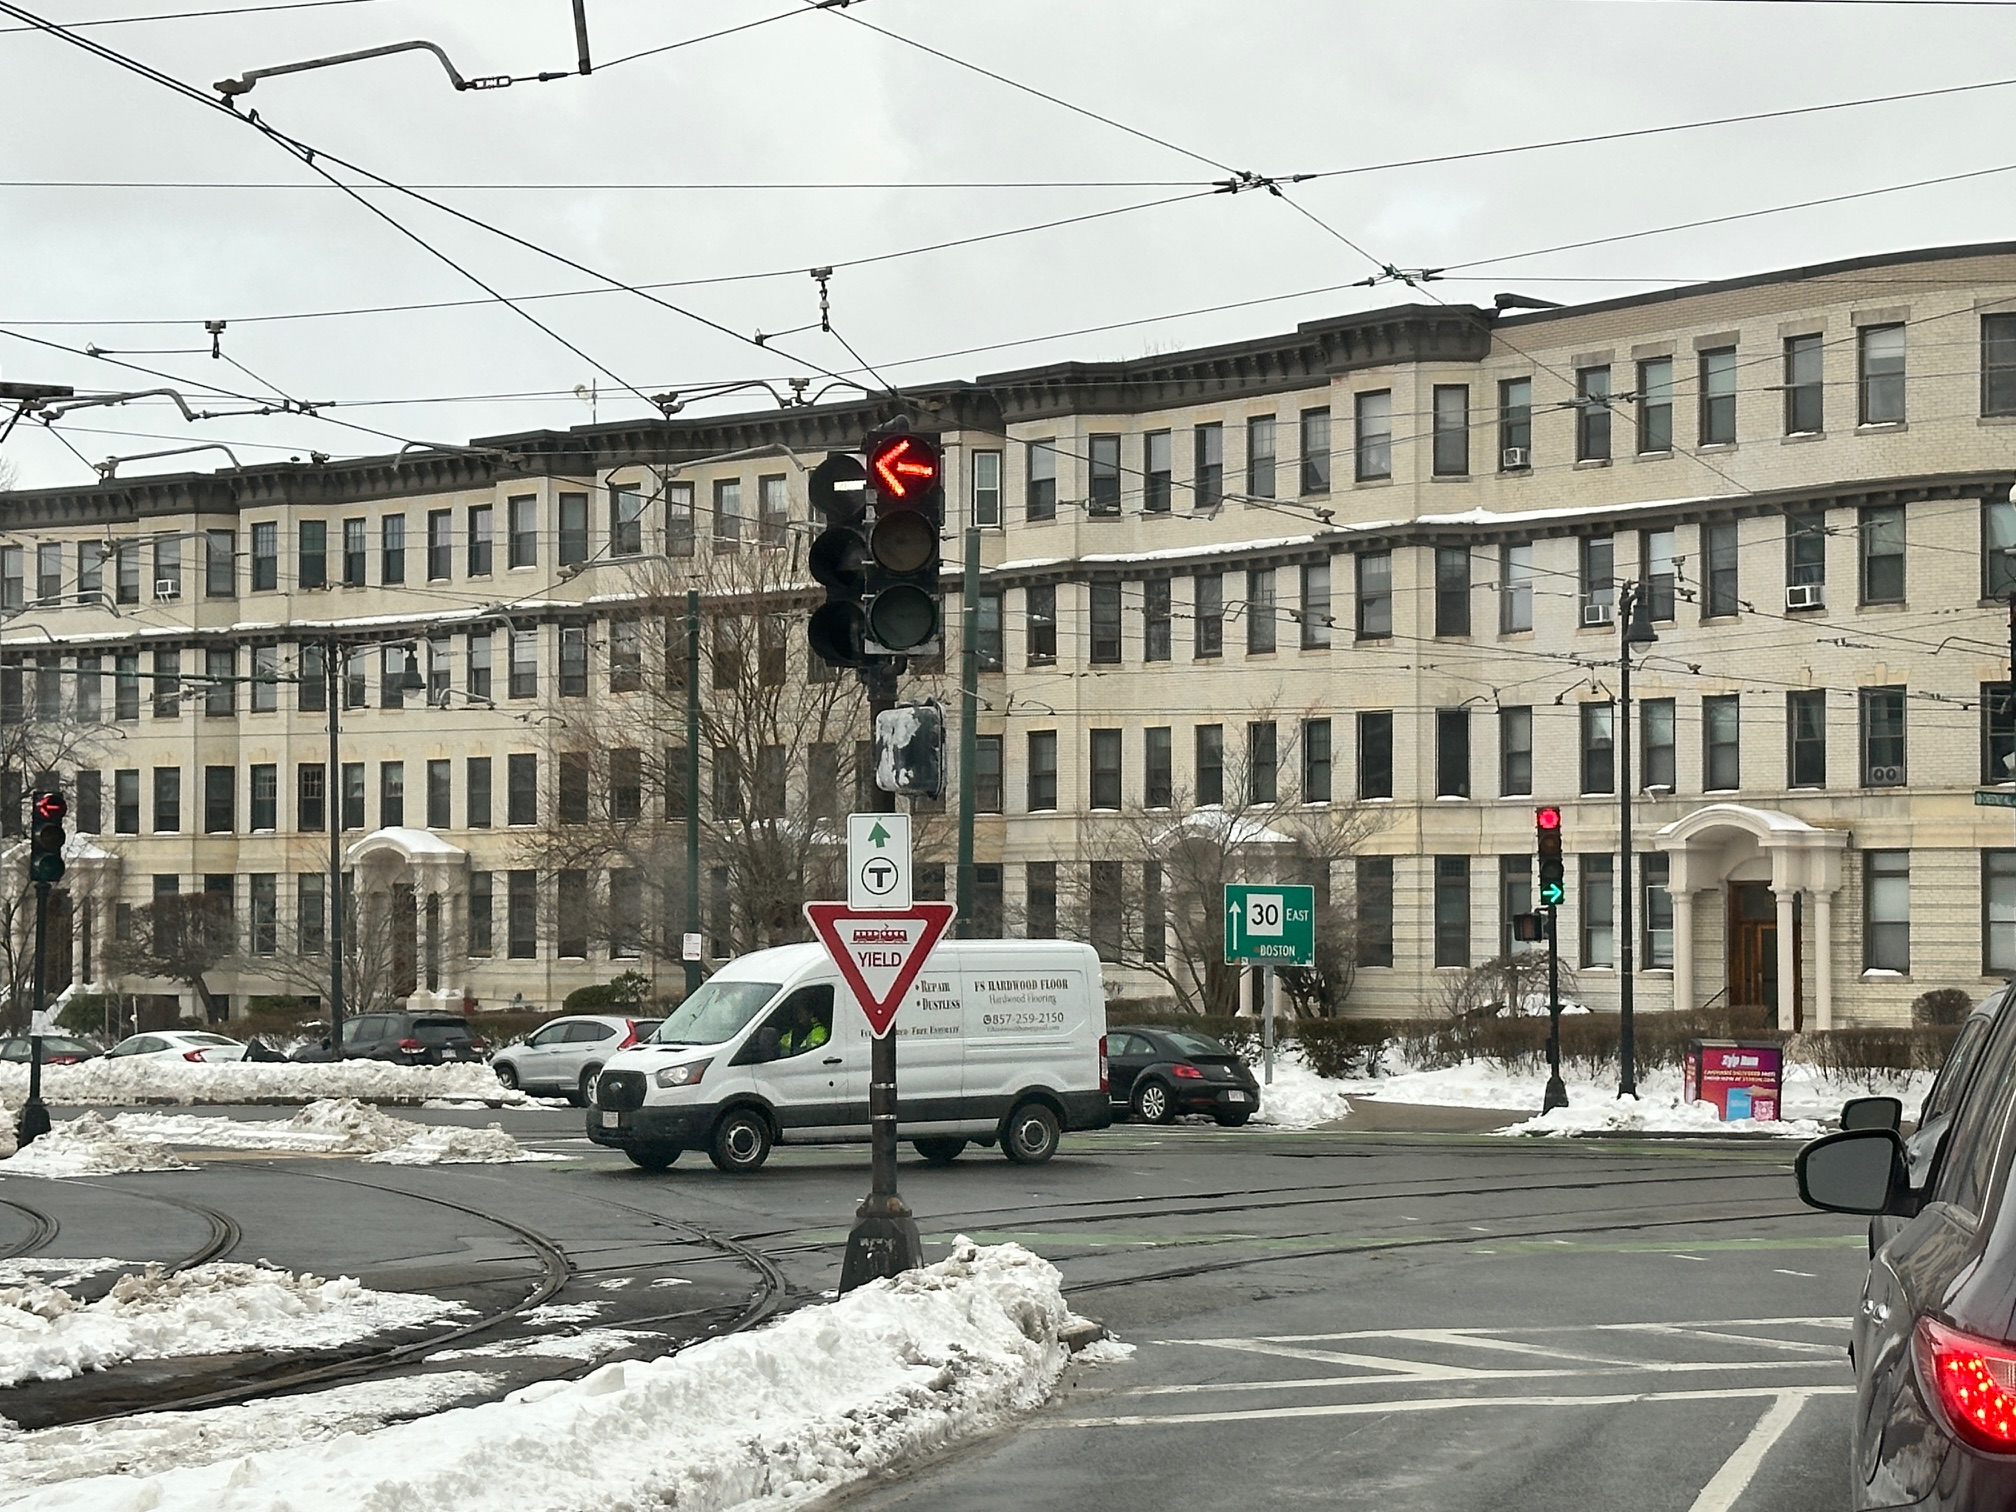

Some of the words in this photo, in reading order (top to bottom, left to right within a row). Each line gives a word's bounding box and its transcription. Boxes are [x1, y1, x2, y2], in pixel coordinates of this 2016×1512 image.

[868, 867, 892, 888] T
[1251, 903, 1279, 926] 30
[1286, 907, 1309, 922] EAST
[1260, 944, 1296, 957] BOSTON
[857, 951, 902, 968] YIELD
[988, 979, 1038, 992] HARDWOOD
[1040, 978, 1069, 991] FLOOR
[992, 1011, 1065, 1025] 857-259-2150
